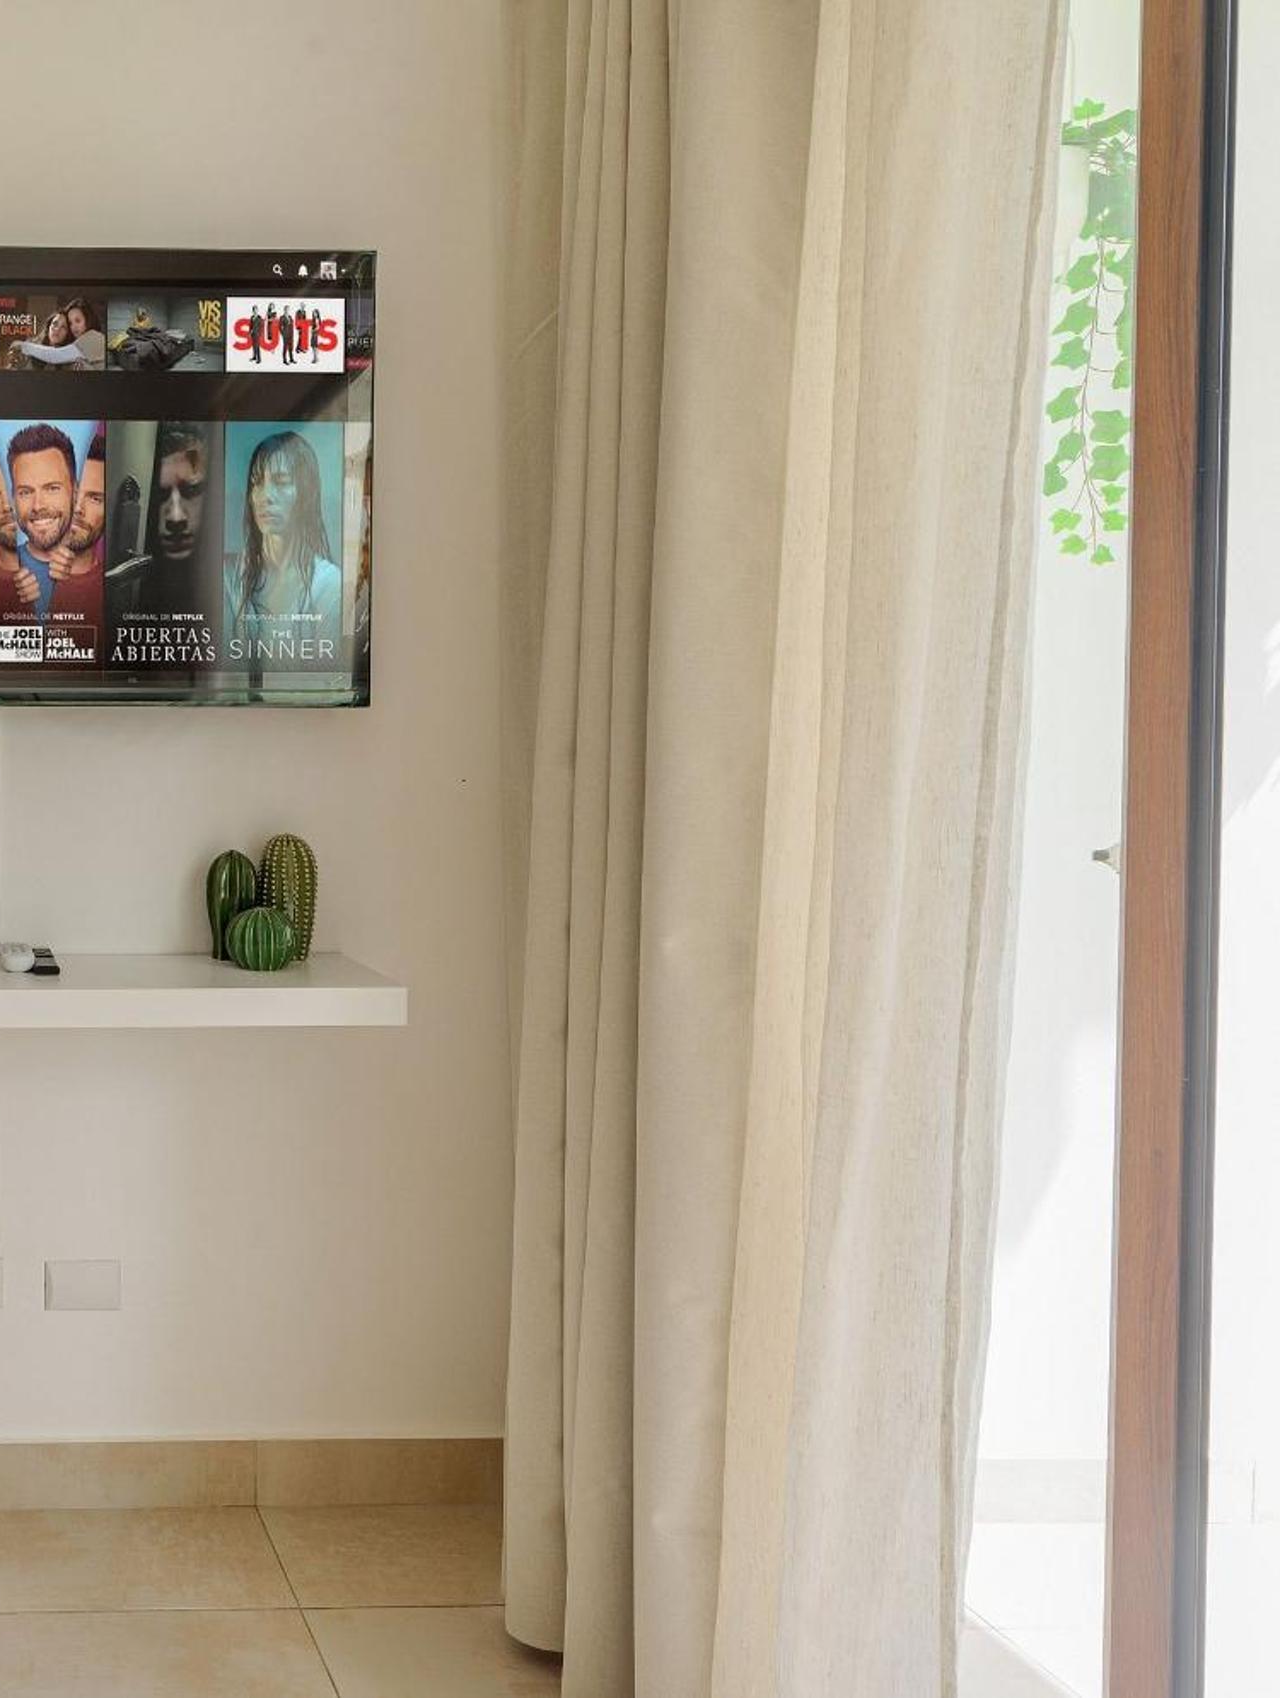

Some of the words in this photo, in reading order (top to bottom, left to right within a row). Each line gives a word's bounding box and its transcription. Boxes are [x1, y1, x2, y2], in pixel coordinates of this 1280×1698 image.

[198, 300, 221, 320] VIS
[0, 325, 33, 336] BLACK
[198, 319, 221, 338] VIS
[233, 317, 338, 351] SUTS
[12, 629, 41, 639] JOEL
[46, 629, 68, 637] WITH
[116, 627, 212, 643] PUERTAS
[46, 638, 76, 648] JOEL
[229, 639, 334, 659] SINNER
[46, 648, 95, 659] McHALE
[111, 645, 216, 661] ABIERTAS
